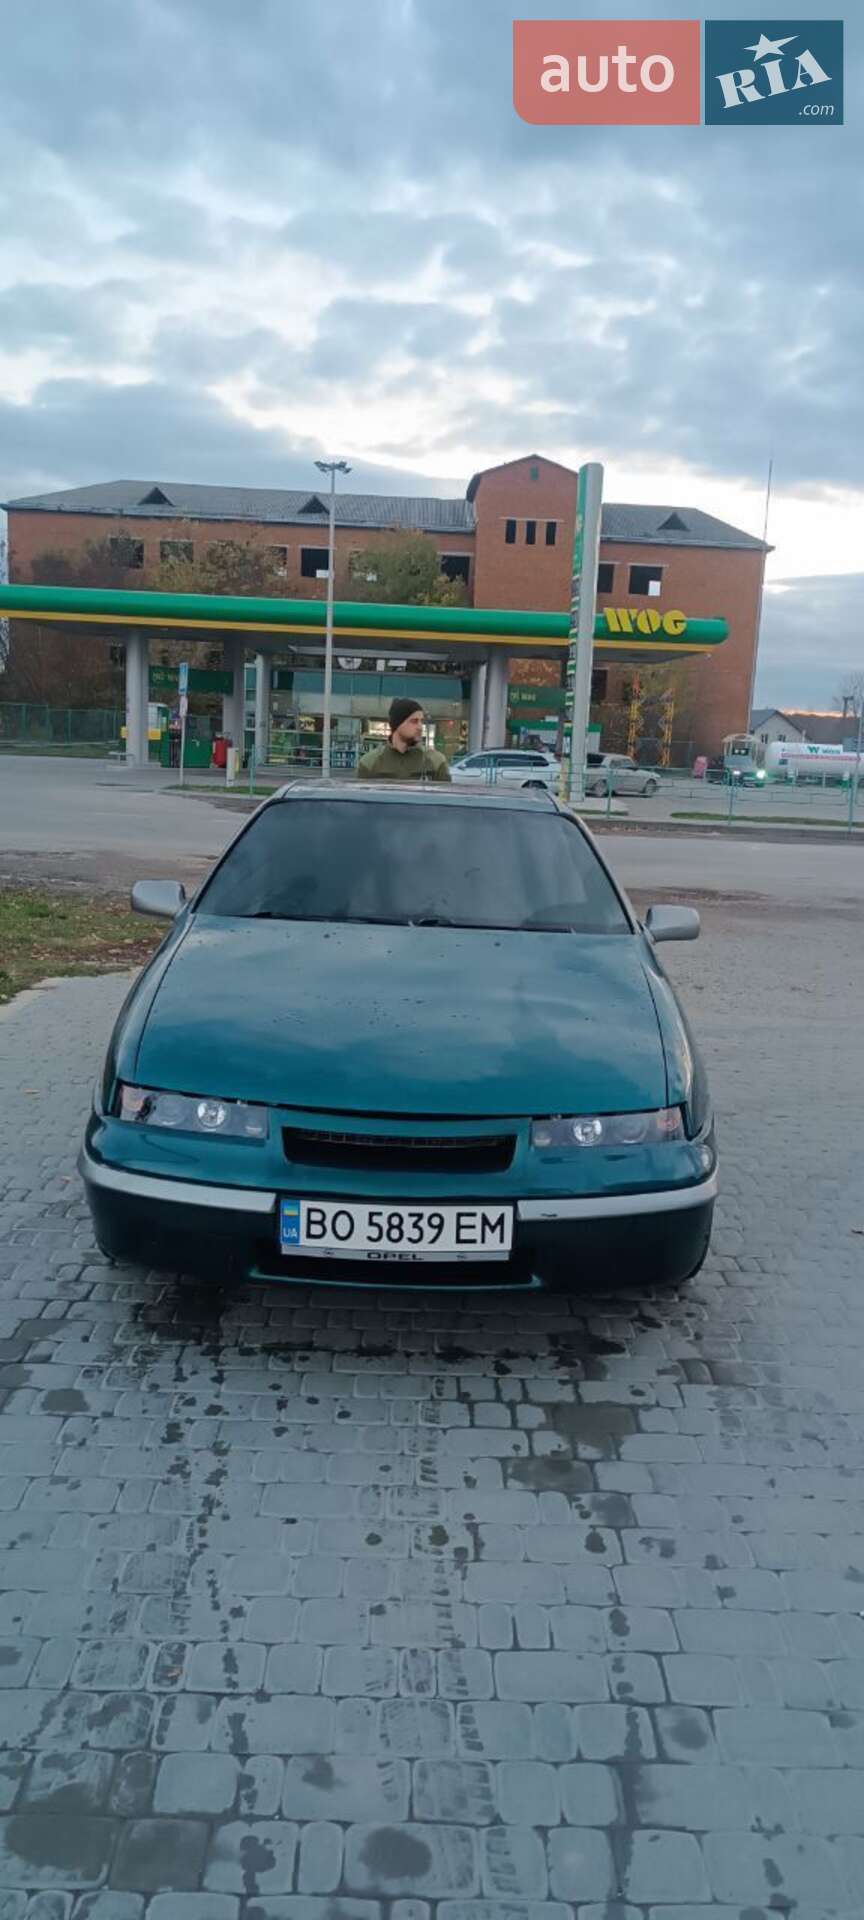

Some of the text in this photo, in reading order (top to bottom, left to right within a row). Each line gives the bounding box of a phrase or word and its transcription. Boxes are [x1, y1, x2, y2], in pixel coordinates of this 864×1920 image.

[603, 608, 687, 635] WOG
[283, 1227, 298, 1238] UA
[306, 1208, 505, 1245] BO 5839 EM
[367, 1252, 424, 1261] OPEL
